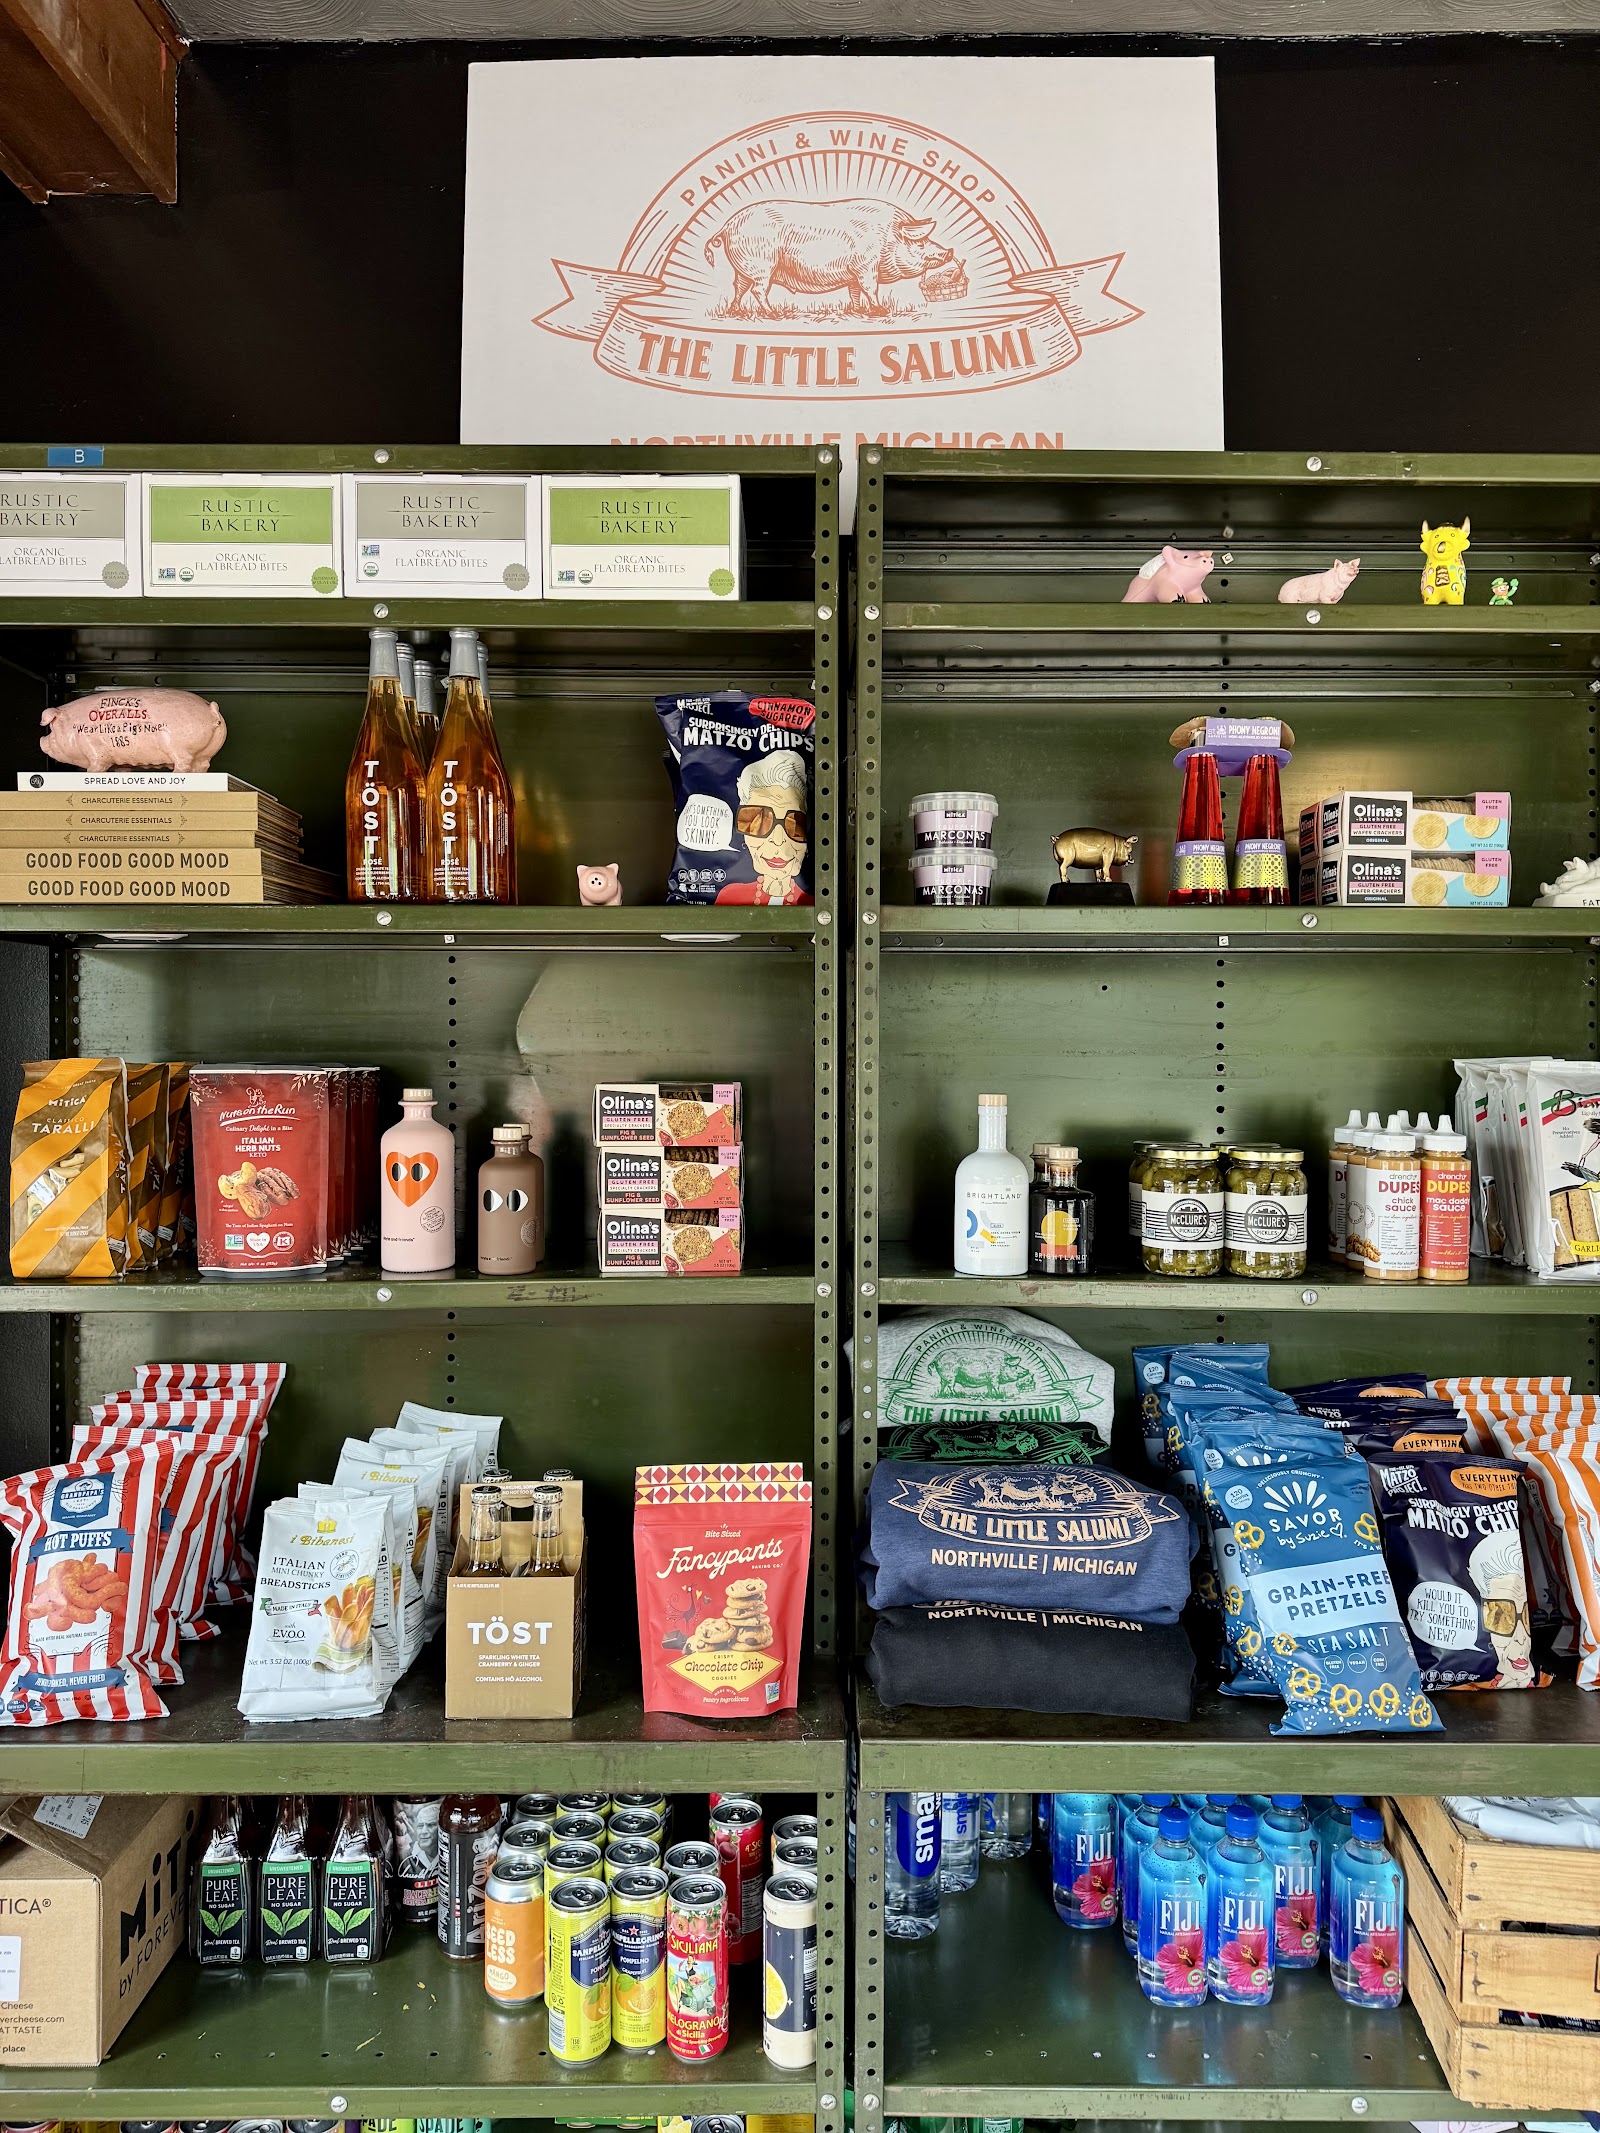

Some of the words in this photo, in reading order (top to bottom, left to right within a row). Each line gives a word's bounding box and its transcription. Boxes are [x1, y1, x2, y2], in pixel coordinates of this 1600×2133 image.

[680, 138, 779, 207] PANINI
[794, 131, 813, 149] &
[829, 128, 908, 157] WINE
[921, 149, 998, 206] SHOP
[637, 332, 711, 382] THE
[731, 343, 859, 388] LITTLE
[879, 328, 1039, 385] SALUMI
[74, 449, 85, 463] B
[0, 494, 79, 508] RUSTIC
[202, 499, 280, 514] RUSTIC
[401, 496, 481, 510] RUSTIC
[600, 501, 678, 515] RUSTIC
[0, 512, 79, 526] BAKERY
[201, 518, 280, 532] BAKERY
[401, 514, 480, 528] BAKERY
[600, 520, 678, 534] BAKERY
[13, 547, 66, 557] ORGANIC
[215, 553, 267, 562] ORGANIC
[416, 549, 467, 559] ORGANIC
[195, 562, 257, 572] FLATBREAD
[260, 562, 288, 572] BITES
[395, 558, 458, 568] FLATBREAD
[460, 558, 488, 568] BITES
[614, 555, 665, 565] ORGANIC
[594, 563, 657, 574] FLATBREAD
[658, 563, 686, 574] BITES
[757, 700, 812, 717] CINNAMON
[89, 710, 148, 722] OVERALLS
[760, 711, 804, 726] SUGARED
[688, 716, 760, 738] SURPRISINGLY
[1228, 725, 1251, 735] PHONY
[1252, 726, 1280, 736] NEGRONI
[110, 736, 130, 748] 1885
[683, 727, 752, 750] MATZO
[759, 731, 815, 752] CHIPS
[84, 777, 119, 785] SPREAD
[121, 777, 145, 785] LOVE
[148, 777, 167, 785] AND
[168, 777, 186, 785] JOY
[1354, 803, 1403, 817] Olina's
[685, 815, 698, 826] YOU
[701, 816, 720, 829] LOOK
[685, 828, 719, 845] SKINNY.
[925, 830, 985, 842] MARCONAS
[26, 852, 73, 869] GOOD
[78, 852, 122, 869] FOOD
[128, 852, 175, 869] GOOD
[180, 852, 229, 869] MOOD
[1352, 862, 1401, 877] Olina's
[28, 880, 75, 897] GOOD
[80, 880, 124, 897] FOOD
[129, 880, 176, 897] GOOD
[182, 880, 230, 897] MOOD
[923, 885, 983, 896] MARCONAS
[32, 1120, 94, 1134] TARALLI
[235, 1144, 257, 1152] HERB
[259, 1144, 281, 1152] NUTS
[1379, 1180, 1420, 1194] DUPES
[1426, 1180, 1470, 1194] DUPES
[966, 1192, 1021, 1200] BRIGHTLAND
[1449, 1196, 1470, 1206] daddy
[1385, 1204, 1417, 1212] sauce
[1432, 1203, 1466, 1212] sauce
[1170, 1215, 1207, 1226] McCLURE'S
[1247, 1215, 1286, 1227] McCLURE'S
[1034, 1252, 1086, 1261] BRIGHTLAND
[902, 1405, 933, 1423] THE
[940, 1406, 990, 1423] LITTLE
[999, 1405, 1062, 1423] SALUMI
[1257, 1470, 1290, 1489] DELICIOUSLY
[1291, 1469, 1321, 1479] CRUNCHY
[1230, 1489, 1244, 1497] 120
[939, 1510, 978, 1536] THE
[986, 1517, 1049, 1542] LITTLE
[1057, 1517, 1131, 1542] SALUMI
[1268, 1508, 1342, 1533] SAVOR
[705, 1530, 719, 1538] Bite
[720, 1529, 741, 1538] Sized
[1277, 1535, 1294, 1549] by
[1296, 1529, 1330, 1545] Suzie
[44, 1535, 68, 1551] HOT
[70, 1531, 112, 1549] PUFFS
[272, 1556, 326, 1569] ITALIAN
[656, 1538, 784, 1580] Fancypants
[931, 1549, 1038, 1570] NORTHVILLE
[1053, 1556, 1138, 1576] MICHIGAN
[271, 1566, 287, 1574] MINI
[289, 1568, 324, 1579] CHUNKY
[260, 1577, 331, 1590] BREADSTICKS
[1267, 1569, 1390, 1604] GRAIN-FREE
[1425, 1588, 1451, 1601] WOULD
[1455, 1592, 1462, 1603] IT
[1287, 1589, 1388, 1621] PRETZELS
[1417, 1599, 1436, 1613] KILL
[1439, 1603, 1455, 1616] YOU
[1458, 1605, 1469, 1616] TO
[928, 1607, 1037, 1624] NORTHVILLE
[1053, 1613, 1143, 1632] MICHIGAN
[1409, 1609, 1425, 1622] TRY
[1427, 1613, 1476, 1631] SOMETHING
[467, 1615, 553, 1645] TÖST
[1428, 1626, 1457, 1645] NEW?
[1307, 1636, 1342, 1654] SEA
[1349, 1626, 1389, 1649] SALT
[685, 1661, 738, 1672] Chocolate
[740, 1658, 764, 1672] Chip
[69, 1675, 88, 1687] NEVER
[89, 1673, 105, 1684] FRIED
[1076, 1832, 1113, 1862] FIJI
[206, 1878, 238, 1890] PURE
[267, 1877, 306, 1889] PURE
[330, 1877, 366, 1889] PURE
[1275, 1864, 1315, 1895] FIJI
[1160, 1899, 1201, 1931] FIJI
[1223, 1896, 1265, 1930] FIJI
[1354, 1899, 1395, 1932] FIJI
[670, 1936, 718, 1954] SICILIANA
[486, 1940, 516, 1965] LESS
[620, 1956, 649, 1964] POMPELMO
[1, 2002, 34, 2010] Cheese
[13, 2026, 42, 2034] TASTE
[3, 2045, 26, 2053] place
